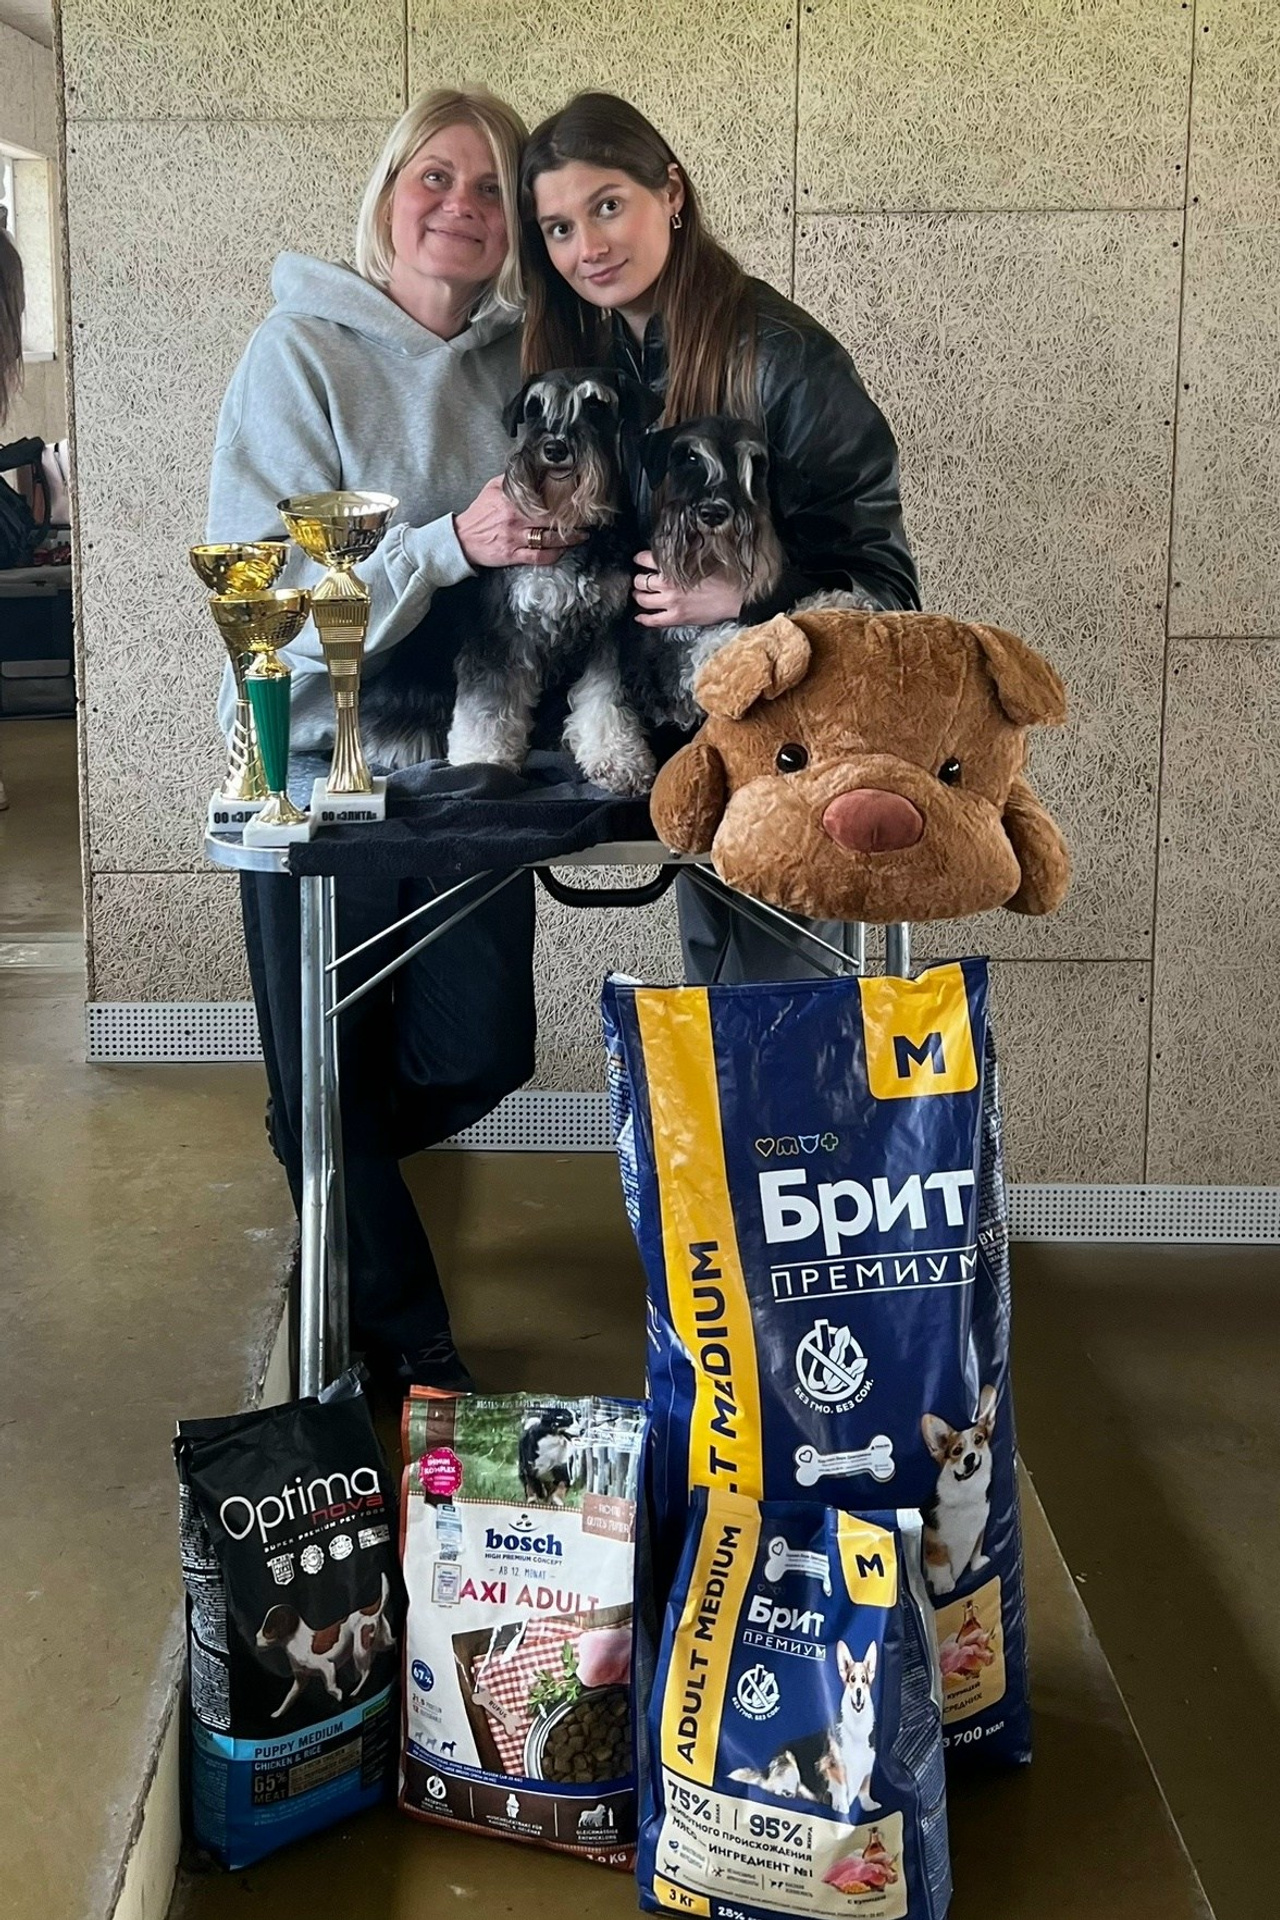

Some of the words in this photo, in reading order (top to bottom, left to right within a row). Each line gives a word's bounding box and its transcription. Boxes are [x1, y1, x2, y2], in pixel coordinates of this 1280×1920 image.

[336, 810, 377, 821] «ЭЛИТА»
[893, 1032, 946, 1078] M
[759, 1168, 975, 1256] Брит
[771, 1251, 978, 1298] ПРЕМИУМ
[794, 1386, 810, 1405] БЕЗ
[835, 1400, 855, 1413] БЕЗ
[219, 1467, 381, 1544] Optima
[311, 1494, 384, 1526] nova
[264, 1538, 294, 1553] SUPER
[298, 1521, 337, 1541] PREMIUM
[339, 1514, 356, 1525] PET
[485, 1528, 563, 1556] bosch
[498, 1566, 508, 1575] AB
[502, 1554, 531, 1562] PREMIUM
[533, 1556, 563, 1566] CONCEPT
[855, 1553, 885, 1578] M
[459, 1578, 507, 1604] AXI
[515, 1584, 599, 1618] ADULT
[747, 1595, 825, 1637] Брит
[677, 1649, 709, 1765] ADULT
[694, 1525, 742, 1641] MEDIUM
[743, 1631, 827, 1659] ПРЕМИУМ
[488, 1700, 507, 1719] RUFUS
[254, 1740, 295, 1759] PUPPY
[298, 1721, 344, 1747] MEDIUM
[953, 1726, 982, 1747] 700
[254, 1756, 293, 1771] CHICKEN
[303, 1745, 322, 1759] RICE
[254, 1790, 286, 1804] MEAT
[667, 1779, 712, 1821] 75%
[749, 1814, 803, 1847] 95%
[609, 1851, 627, 1864] KG
[708, 1843, 791, 1873] ИНГРЕДИЕНТ
[722, 1831, 813, 1862] ПРОИСХОЖДЕНИЯ
[669, 1888, 677, 1901] 3
[679, 1893, 695, 1908] КГ
[717, 1906, 746, 1920] 28%
